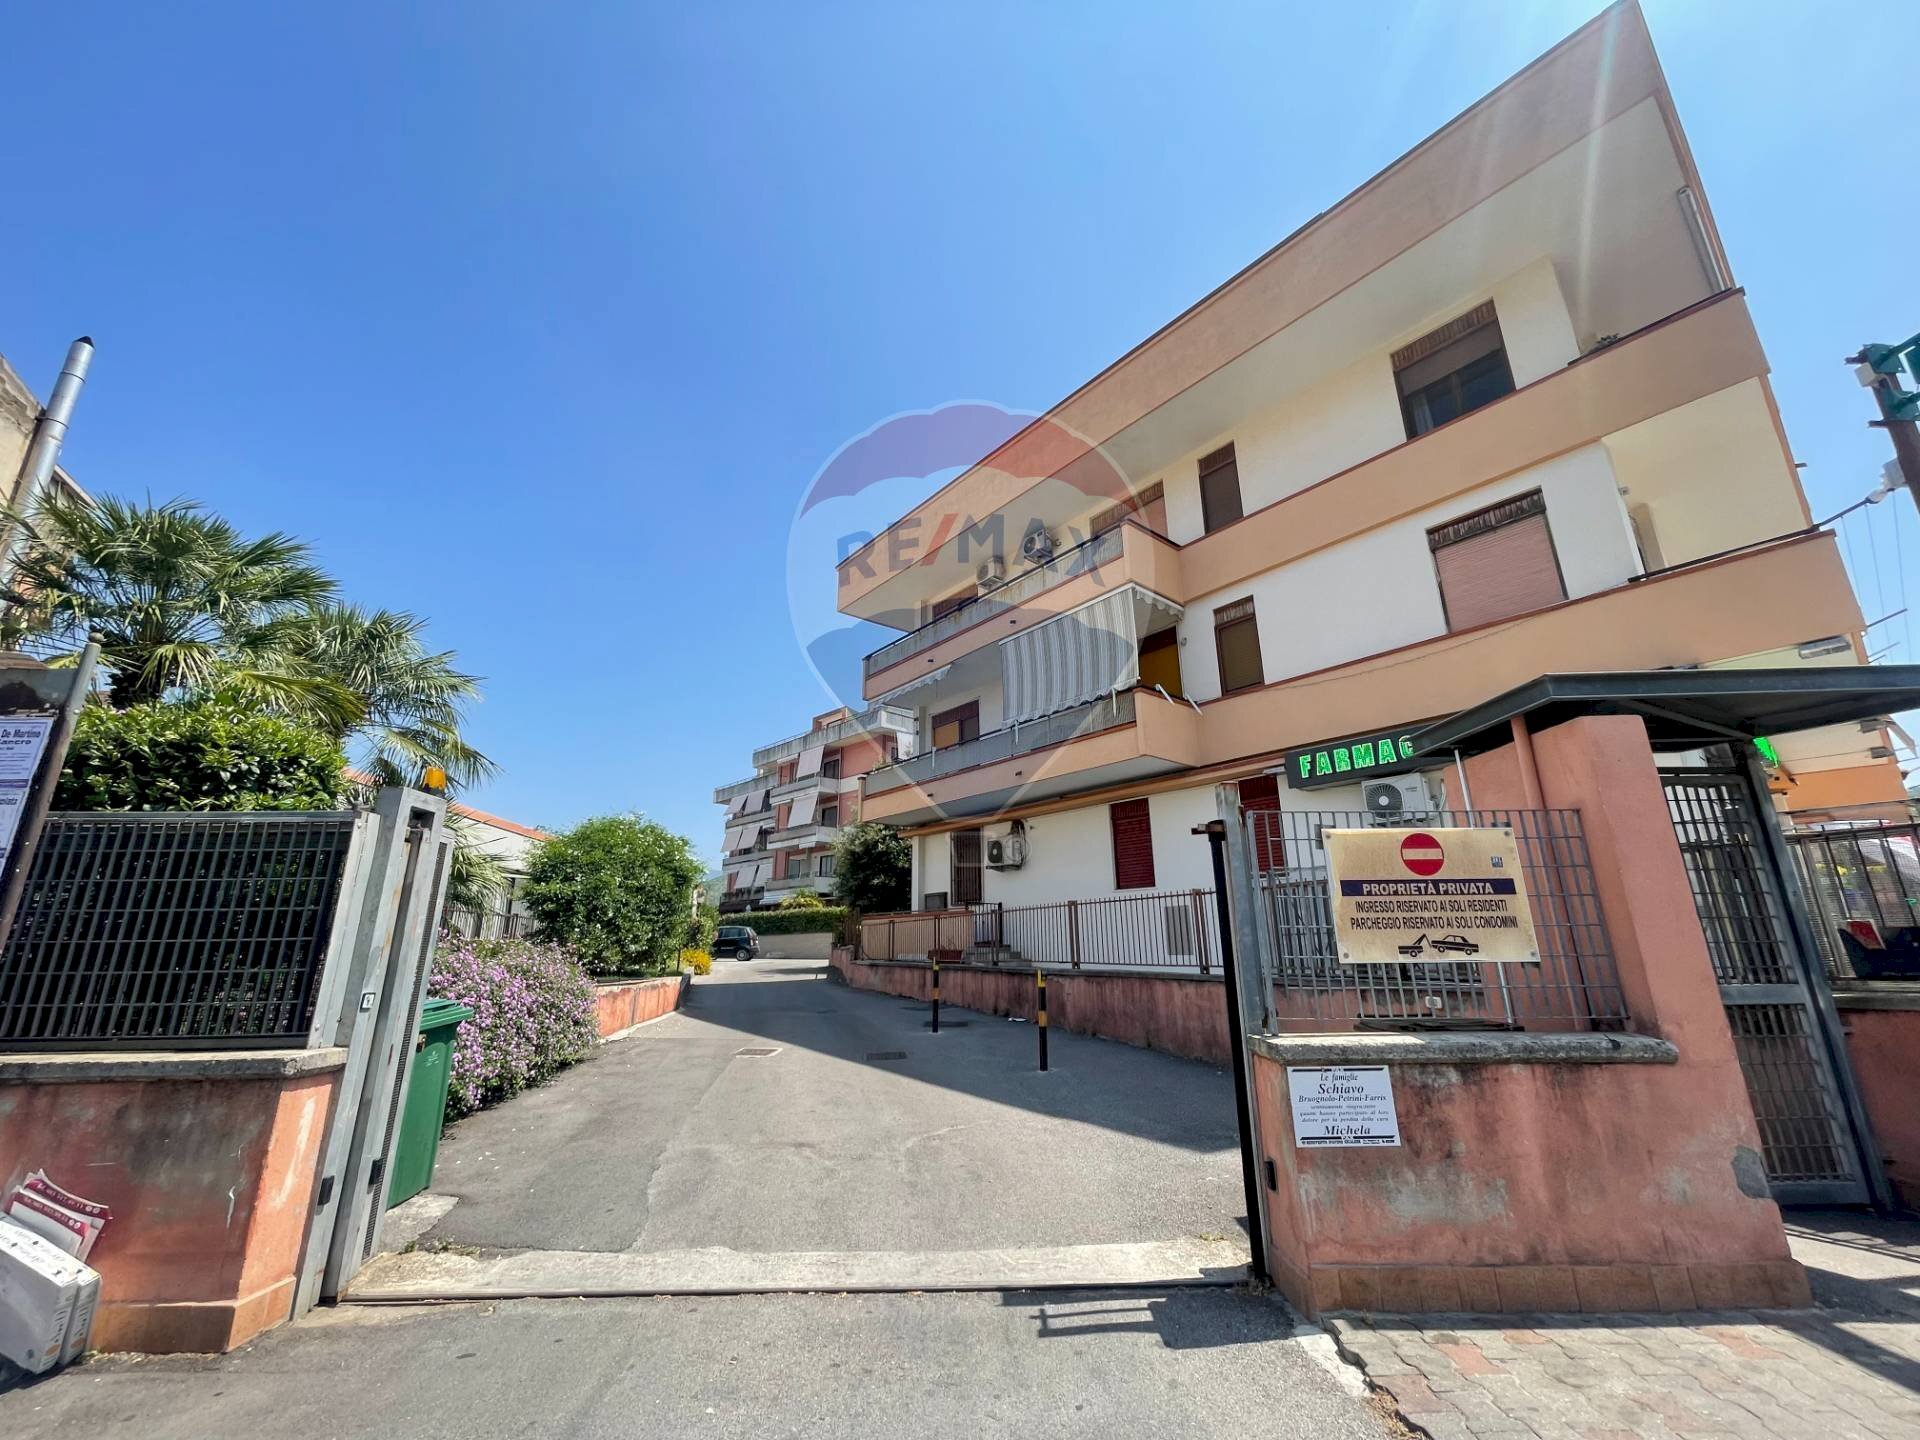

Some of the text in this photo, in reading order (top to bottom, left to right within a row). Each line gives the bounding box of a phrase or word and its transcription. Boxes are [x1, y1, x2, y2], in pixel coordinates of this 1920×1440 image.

[1, 729, 11, 738] De
[1362, 881, 1494, 895] PROPRIETÀ PRIVATA
[1355, 900, 1508, 913] INGRESSO RISERVATO AI SOLI RESIDENTI
[1351, 916, 1518, 930] PARCHEGGIO RISERVATO AI SOLI CONDOMINI
[1320, 1073, 1358, 1083] Le famiglie
[1318, 1083, 1364, 1094] Schiavo
[1324, 1124, 1371, 1135] Michela
